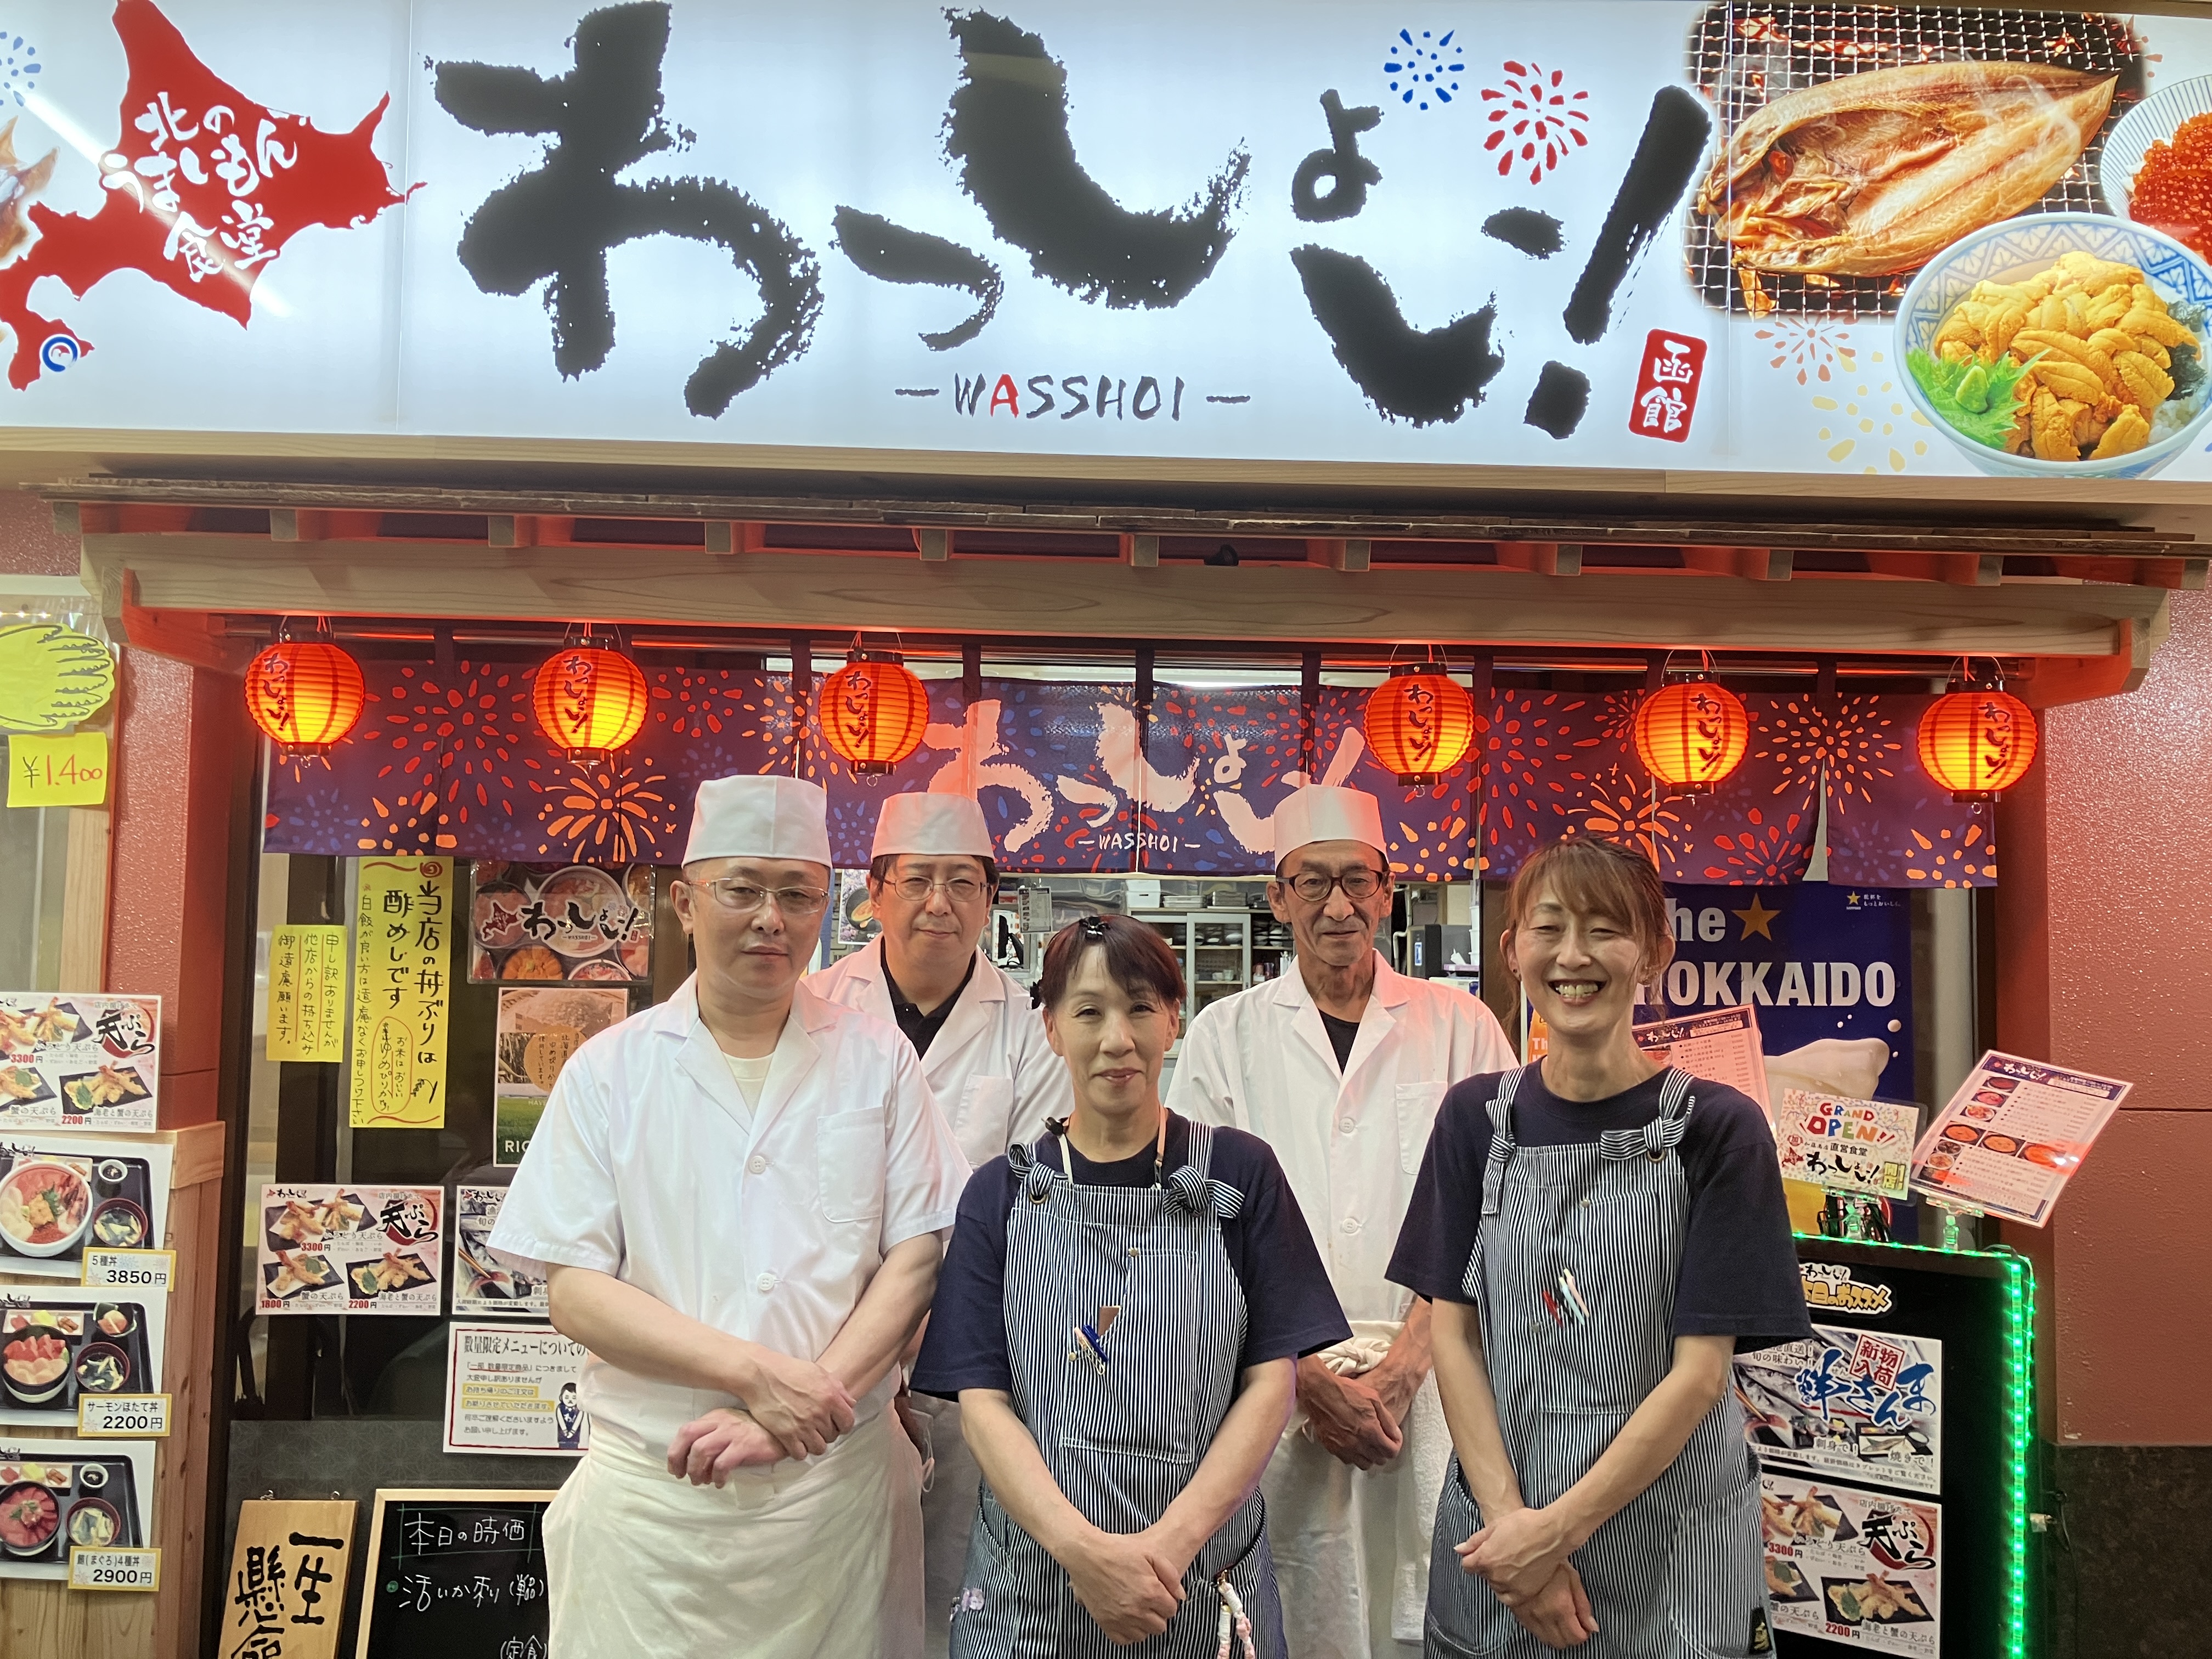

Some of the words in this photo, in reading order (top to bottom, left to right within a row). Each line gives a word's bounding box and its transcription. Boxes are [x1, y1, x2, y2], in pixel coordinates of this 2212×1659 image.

[135, 91, 235, 151] 北の
[103, 118, 298, 213] うまいもん
[163, 200, 278, 282] 食堂
[1640, 339, 1694, 433] 函館
[1666, 898, 1726, 942] he
[382, 890, 415, 1009] 酢めしです
[414, 880, 444, 1064] 当店の丼ぶりは
[302, 934, 318, 1055] 他店からの持ち込み
[321, 933, 338, 1048] 申し訳ありませんが
[10, 1054, 43, 1064] 3300円
[61, 1115, 92, 1125] 2200円
[1820, 1103, 1875, 1121] GRAND
[301, 1243, 331, 1252] 3300円
[106, 1270, 167, 1285] 3850円
[348, 1300, 377, 1310] 2200円
[464, 1335, 590, 1357] 数量限定メニューについての
[88, 1402, 159, 1413] サーモンほたて丼
[103, 1415, 163, 1429] 2200円
[404, 1513, 525, 1555] 本日の時価
[1768, 1542, 1803, 1559] 3300円
[93, 1569, 153, 1584] 2900円
[289, 1532, 345, 1625] 一生
[1825, 1622, 1860, 1640] 2200円
